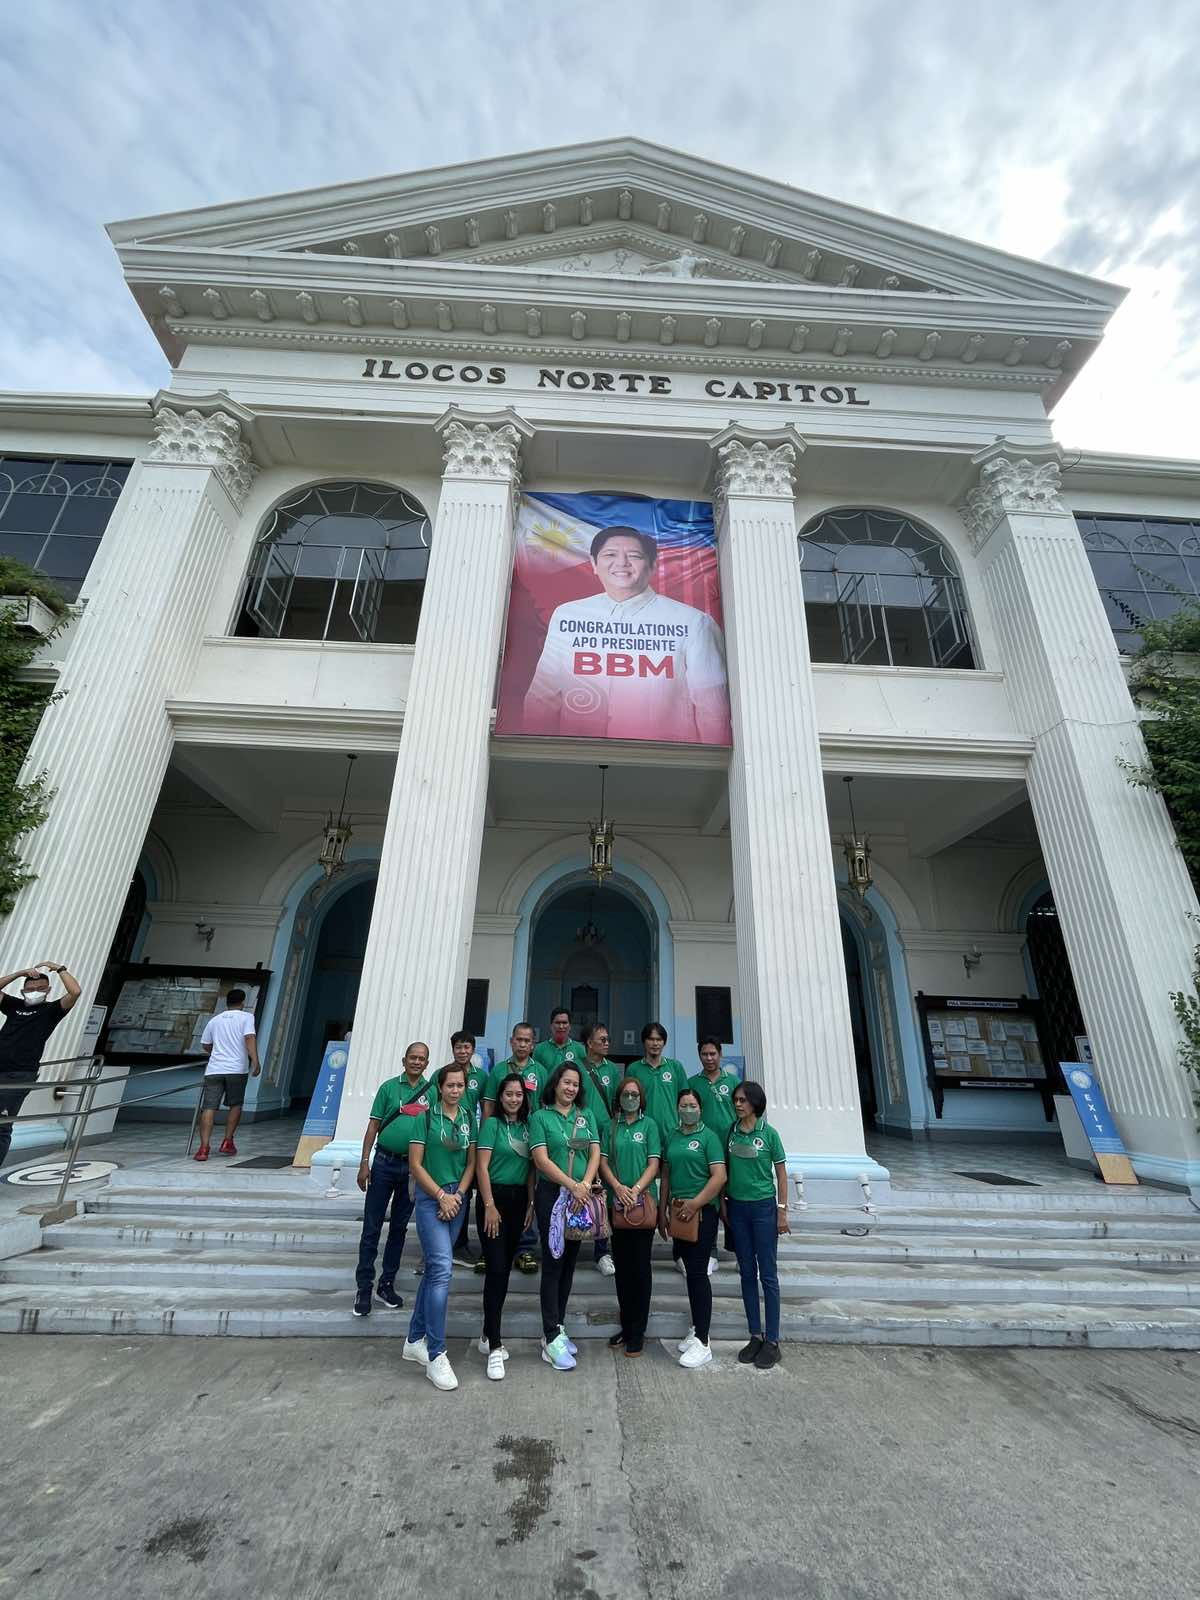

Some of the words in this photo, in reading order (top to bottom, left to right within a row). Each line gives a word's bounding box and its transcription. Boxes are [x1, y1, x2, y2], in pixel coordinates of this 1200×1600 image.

[362, 359, 506, 385] ILOCOS
[537, 368, 672, 395] NORTE
[704, 379, 871, 406] CAPITOL
[559, 619, 689, 638] CONGRATULATIONS!
[572, 636, 598, 649] APO
[602, 637, 676, 652] PRESIDENTE
[573, 652, 674, 679] BBM
[320, 1074, 337, 1114] EXIT
[1084, 1093, 1103, 1133] EXIT
